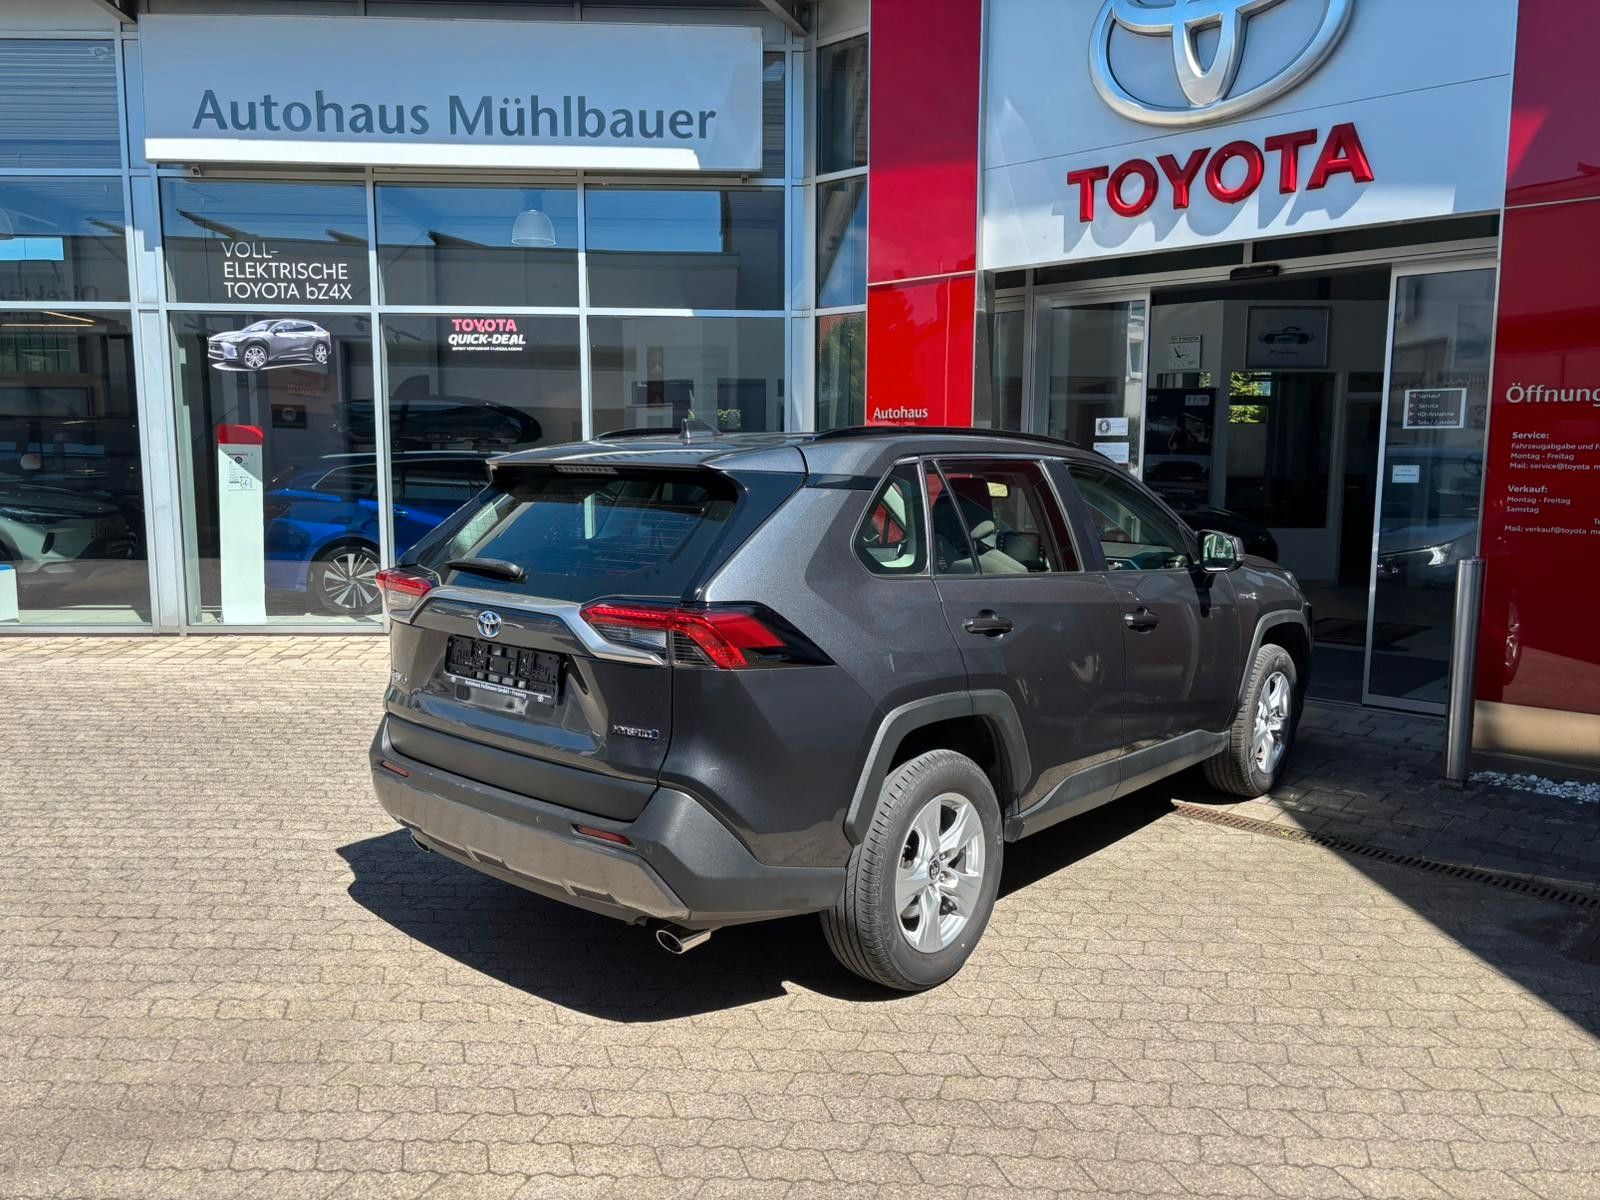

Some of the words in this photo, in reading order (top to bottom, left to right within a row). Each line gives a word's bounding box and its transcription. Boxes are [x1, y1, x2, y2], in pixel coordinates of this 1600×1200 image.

[193, 89, 430, 135] Autohaus
[448, 94, 716, 139] Mühlbauer
[1067, 122, 1374, 222] TOYOTA
[221, 241, 278, 258] VOLL-
[224, 262, 348, 279] ELEKTRISCHE
[224, 282, 300, 299] TOYOTA
[306, 282, 352, 299] bZ4X
[452, 319, 517, 332] TOYOTA
[448, 334, 526, 345] QUICK-DEAL
[873, 405, 928, 419] Autohaus
[1512, 431, 1549, 439] Service:
[1511, 443, 1576, 451] Fahrzeugabgabe
[1510, 453, 1540, 461] Montag
[1547, 453, 1574, 461] Freitag
[1508, 485, 1548, 493] Verkauf:
[1506, 496, 1537, 504] Montag
[1543, 497, 1571, 505] Freitag
[1505, 506, 1539, 514] Samstag
